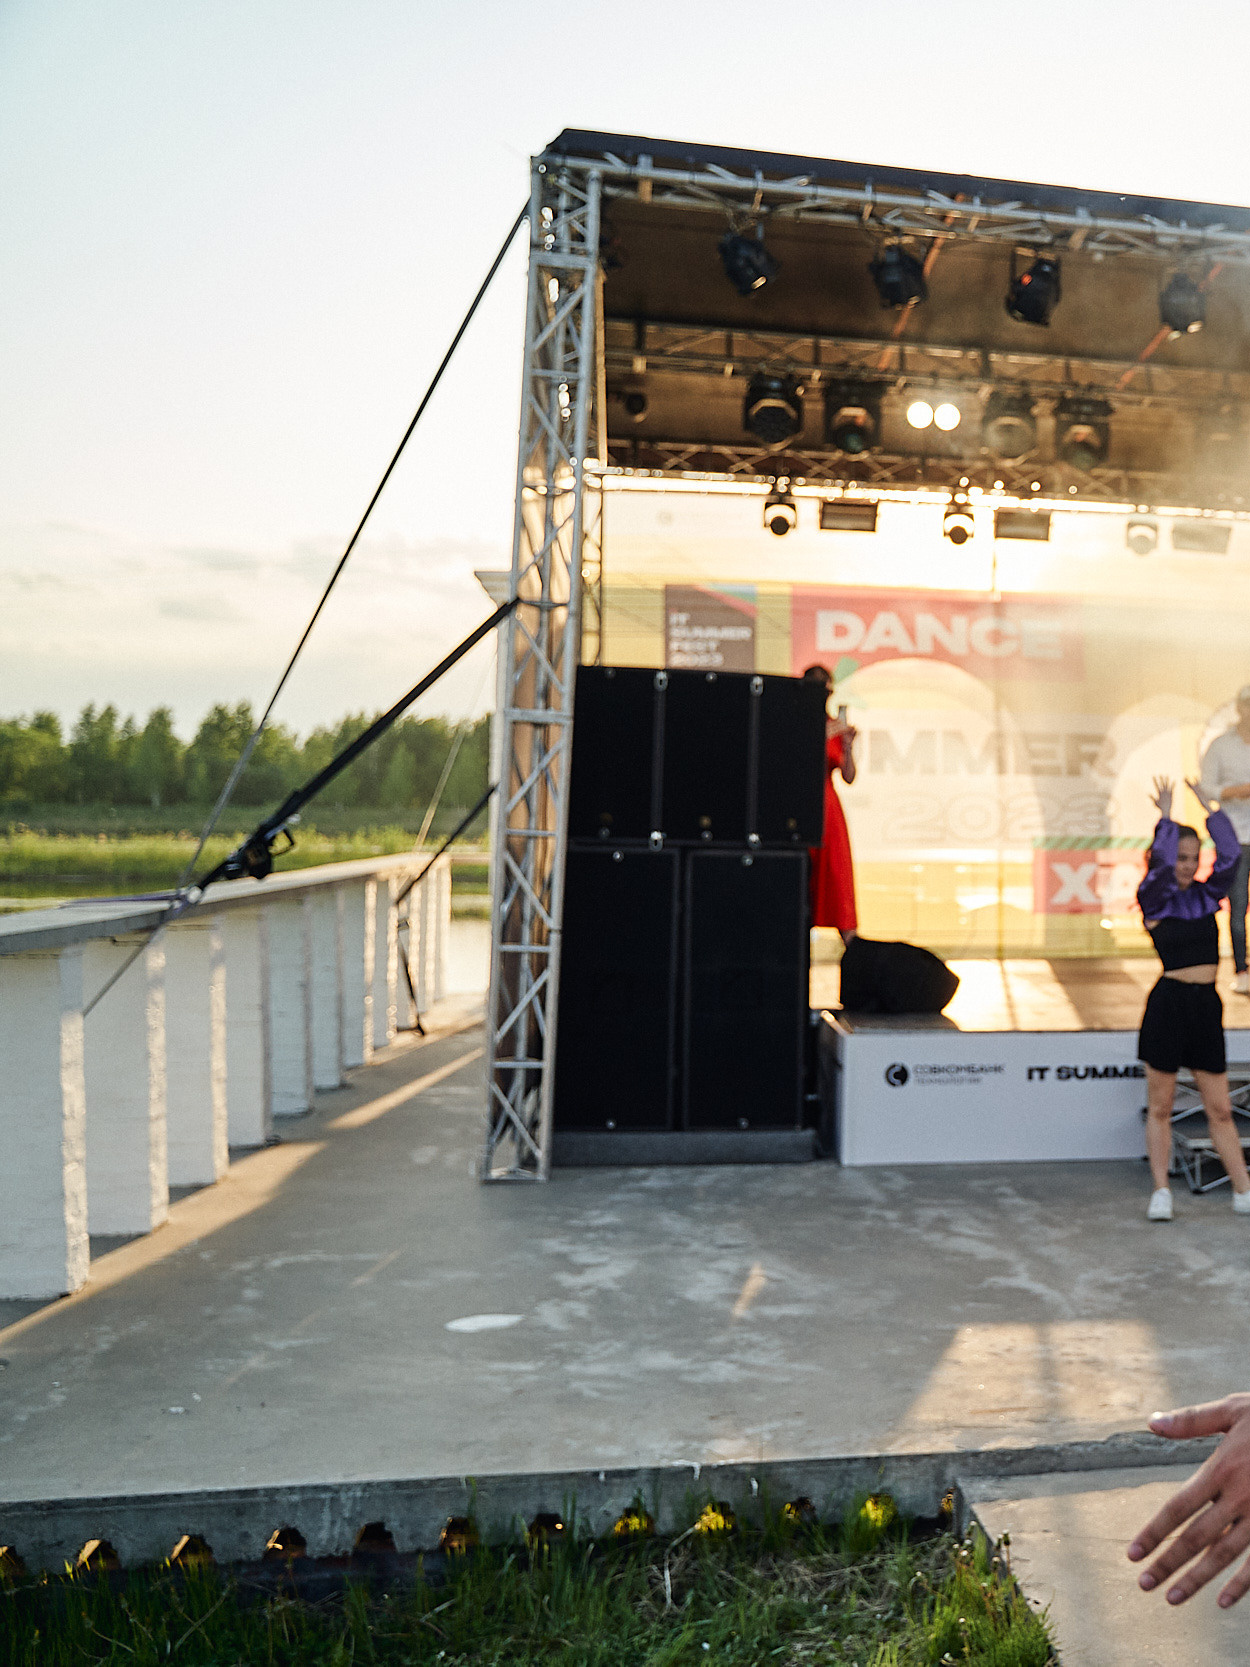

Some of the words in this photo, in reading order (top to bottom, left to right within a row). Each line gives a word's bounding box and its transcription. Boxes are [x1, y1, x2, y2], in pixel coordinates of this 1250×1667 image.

[814, 608, 1066, 660] DANCE
[1027, 1066, 1050, 1080] IT
[1056, 1065, 1147, 1079] SUMME
